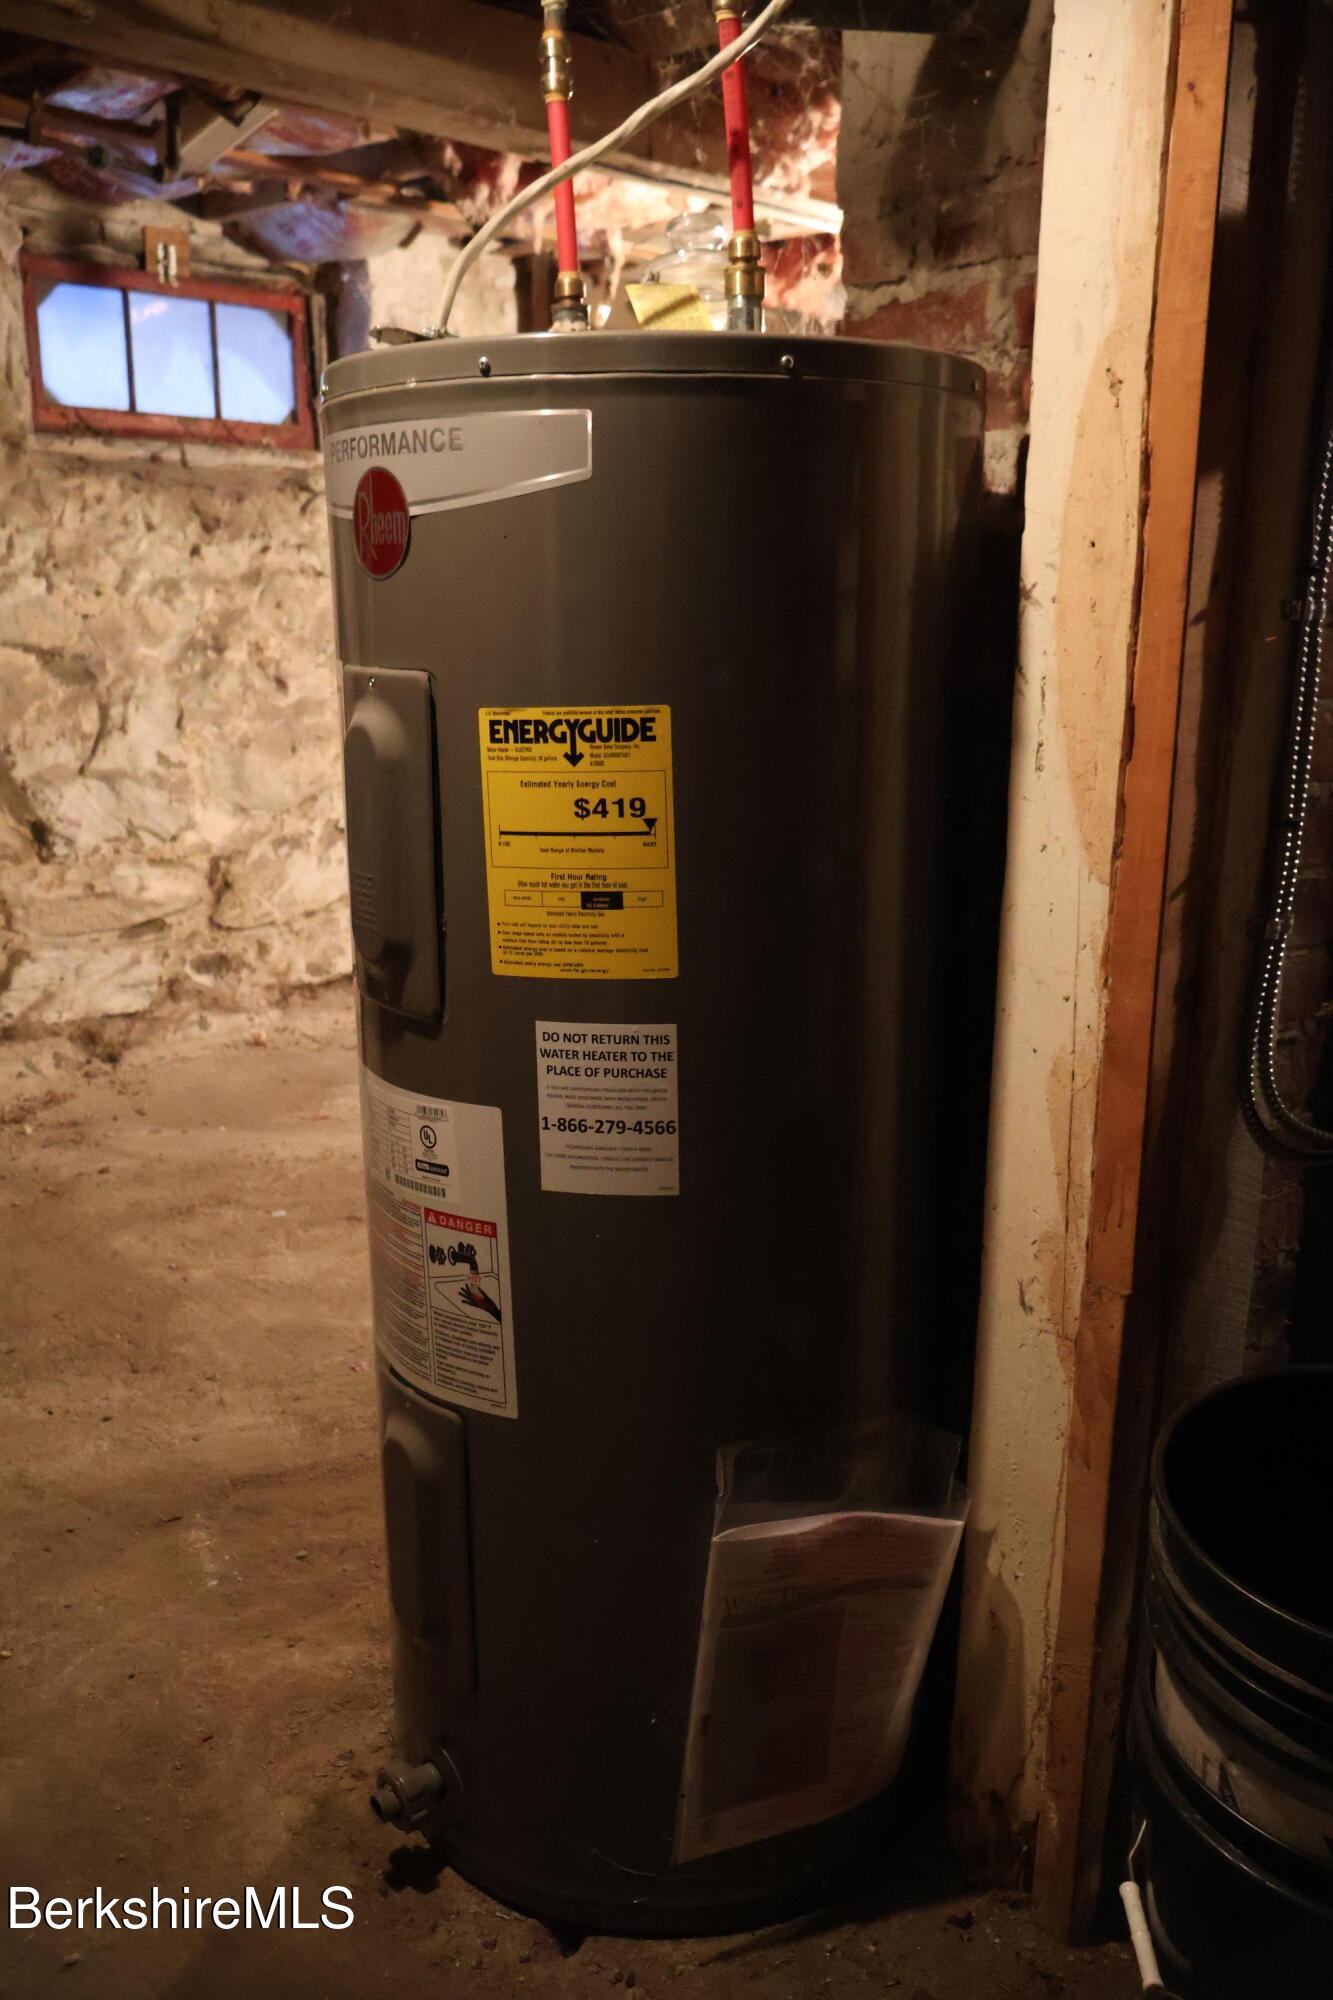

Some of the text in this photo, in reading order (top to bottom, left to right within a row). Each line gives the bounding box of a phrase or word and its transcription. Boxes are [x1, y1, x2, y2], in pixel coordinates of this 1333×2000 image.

[330, 427, 464, 463] PERFORMANCE
[488, 716, 657, 744] ENERGYGUIDE
[520, 779, 617, 789] Estimated Yearly Energy Cost
[573, 797, 647, 820] $419
[551, 872, 608, 882] First Hour Rating
[542, 1031, 671, 1045] DO NOT RETURN THIS
[539, 1047, 674, 1062] WATER HEATER TO THE
[546, 1065, 667, 1079] PLACE OF PURCHASE
[541, 1116, 677, 1135] 1-866-279-4566
[439, 1215, 492, 1235] DANGER
